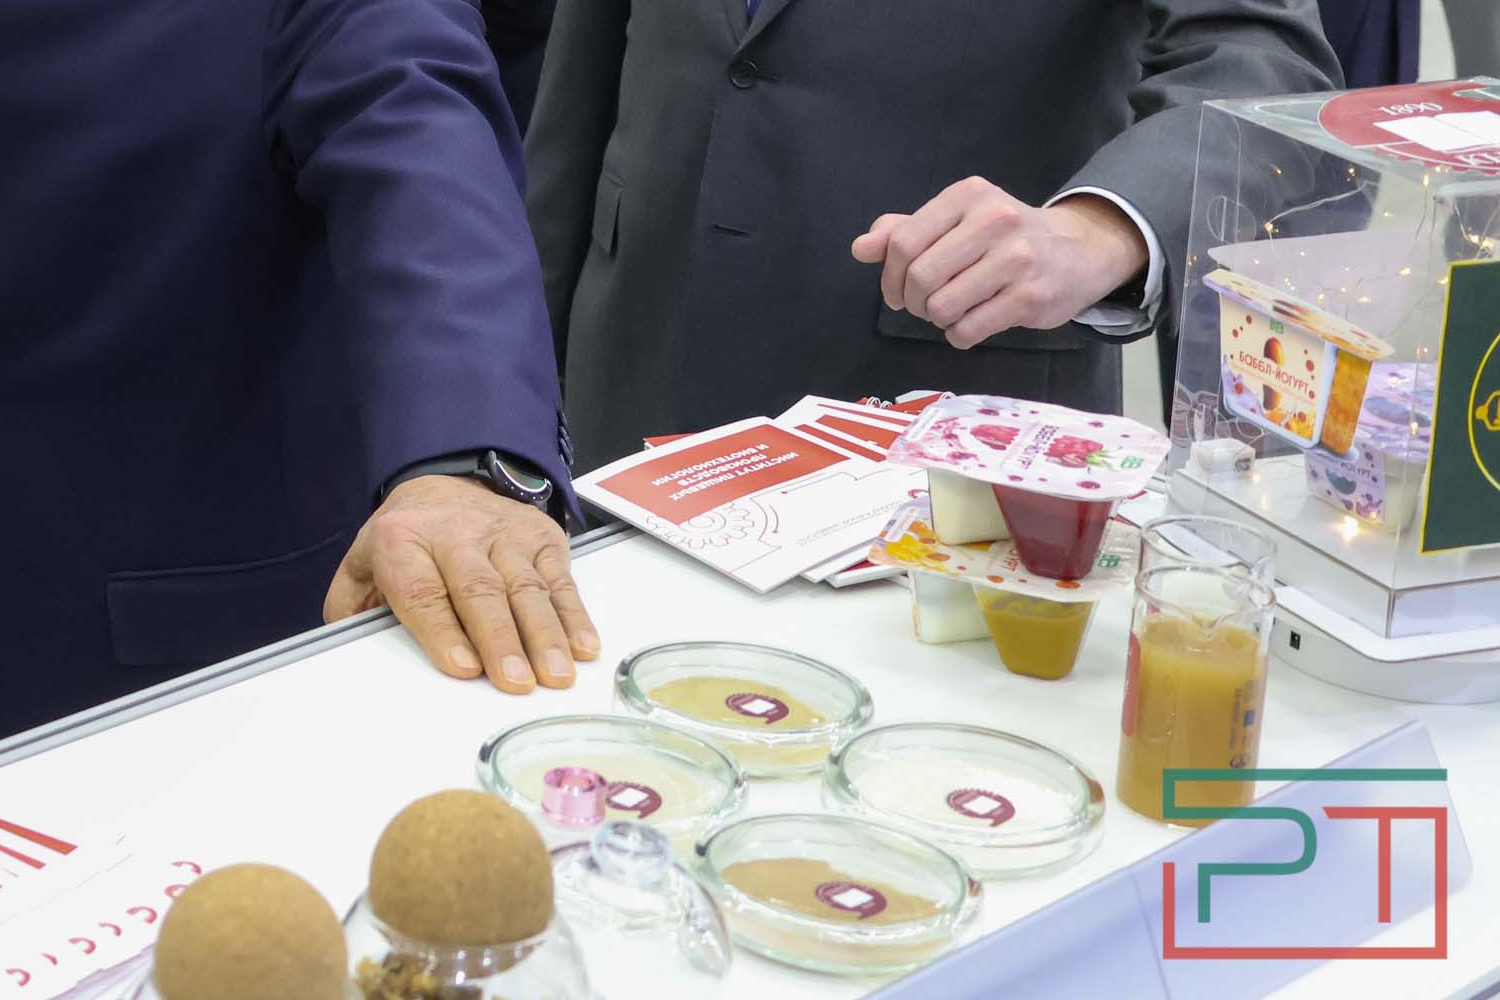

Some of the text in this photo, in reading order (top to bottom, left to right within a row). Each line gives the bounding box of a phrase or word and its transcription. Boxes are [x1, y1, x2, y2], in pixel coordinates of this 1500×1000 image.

[1378, 102, 1443, 116] 1890
[651, 443, 770, 487] И БИОТЕХНОЛОГИИ
[668, 452, 800, 501] ИНСТИТУТ ПИЩЕВЫХ
[677, 454, 768, 487] ПРОИЗВОДСТВ
